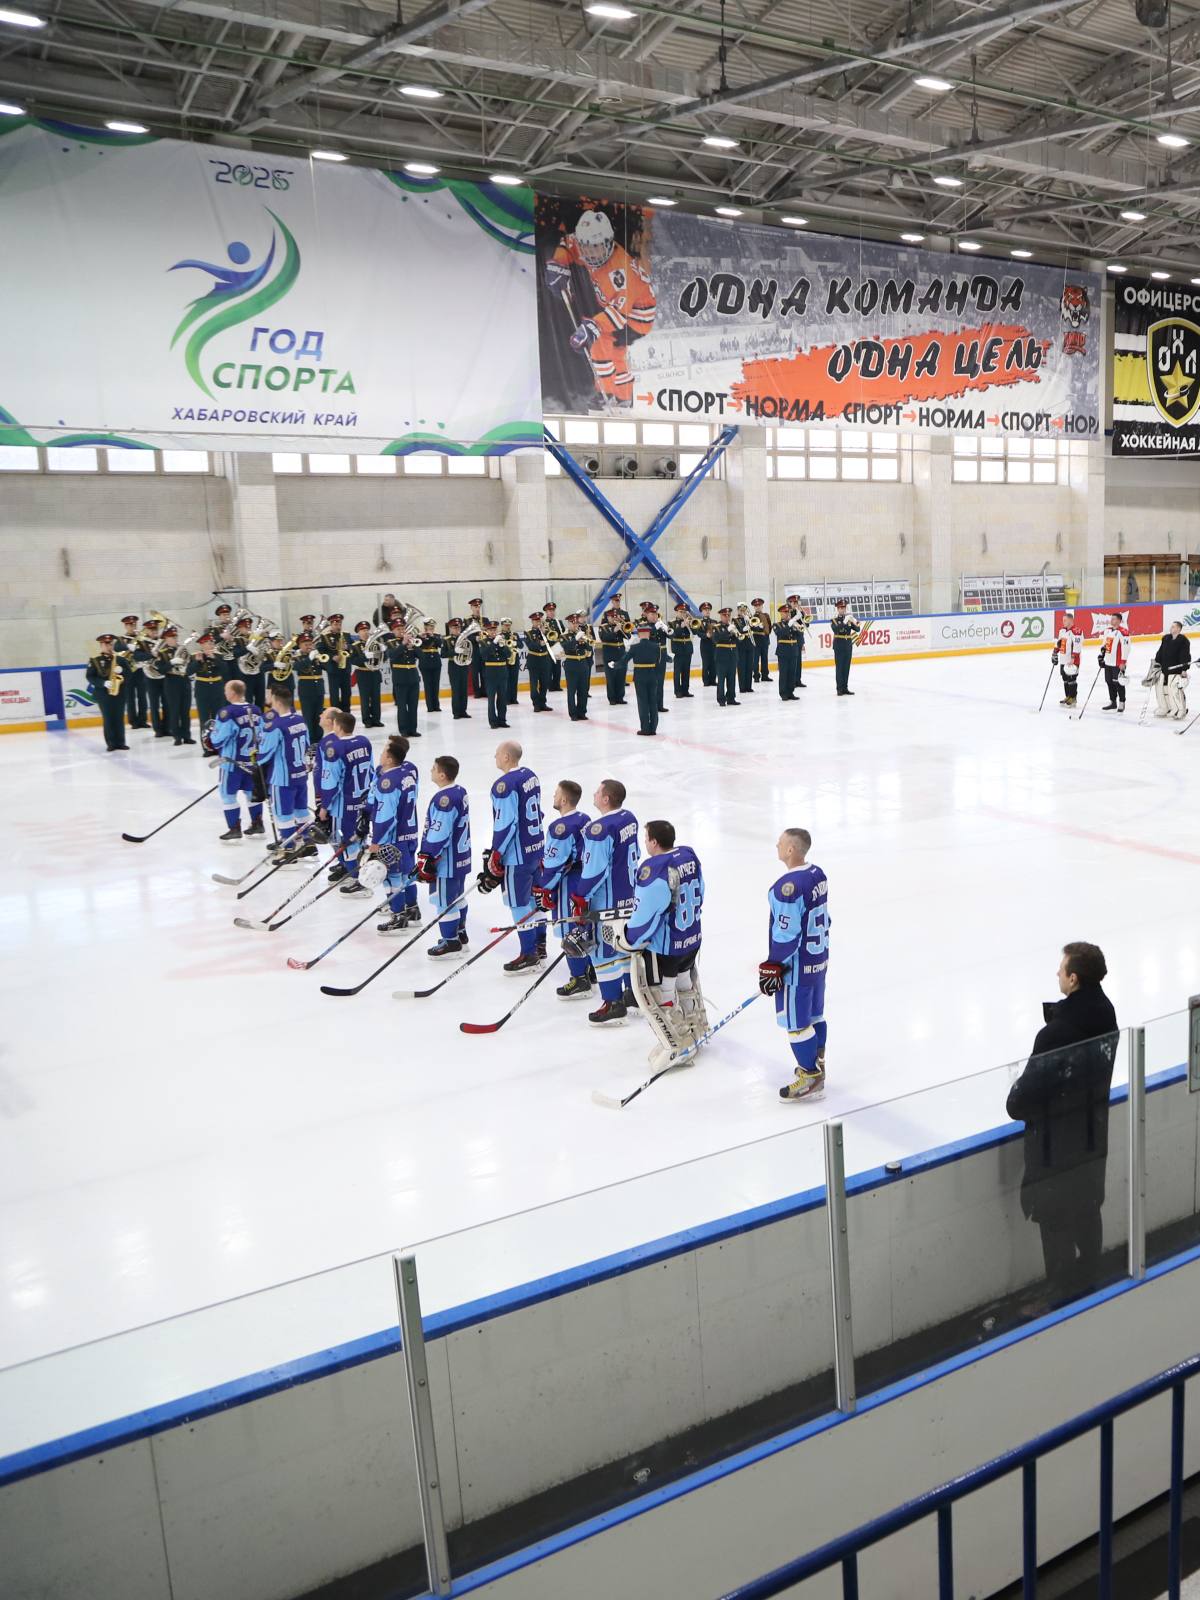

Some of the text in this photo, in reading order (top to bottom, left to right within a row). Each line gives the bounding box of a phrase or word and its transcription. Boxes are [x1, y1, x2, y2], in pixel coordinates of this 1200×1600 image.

[679, 272, 1026, 320] ОДНА КОМАНДА
[250, 327, 325, 361] ГОД
[826, 339, 943, 383] ОДНА
[953, 336, 1044, 380] ЦЕЛЬ
[212, 362, 356, 395] СПОРТА
[171, 407, 358, 427] ХАБАРОВСКИЙ КРАЙ
[656, 388, 728, 415] СПОРТ
[745, 394, 826, 423] НОРМА
[843, 402, 903, 425] СПОРТ
[918, 406, 985, 430] НОРМА
[1001, 410, 1052, 432] СПОРТ
[1121, 433, 1196, 451] ХОККЕЙНАЯ
[861, 629, 891, 646] 2025
[941, 624, 998, 640] Самбери
[1021, 616, 1044, 639] 20
[351, 761, 371, 799] 17
[430, 819, 442, 832] 23
[457, 814, 472, 854] 2
[600, 907, 634, 921] CC
